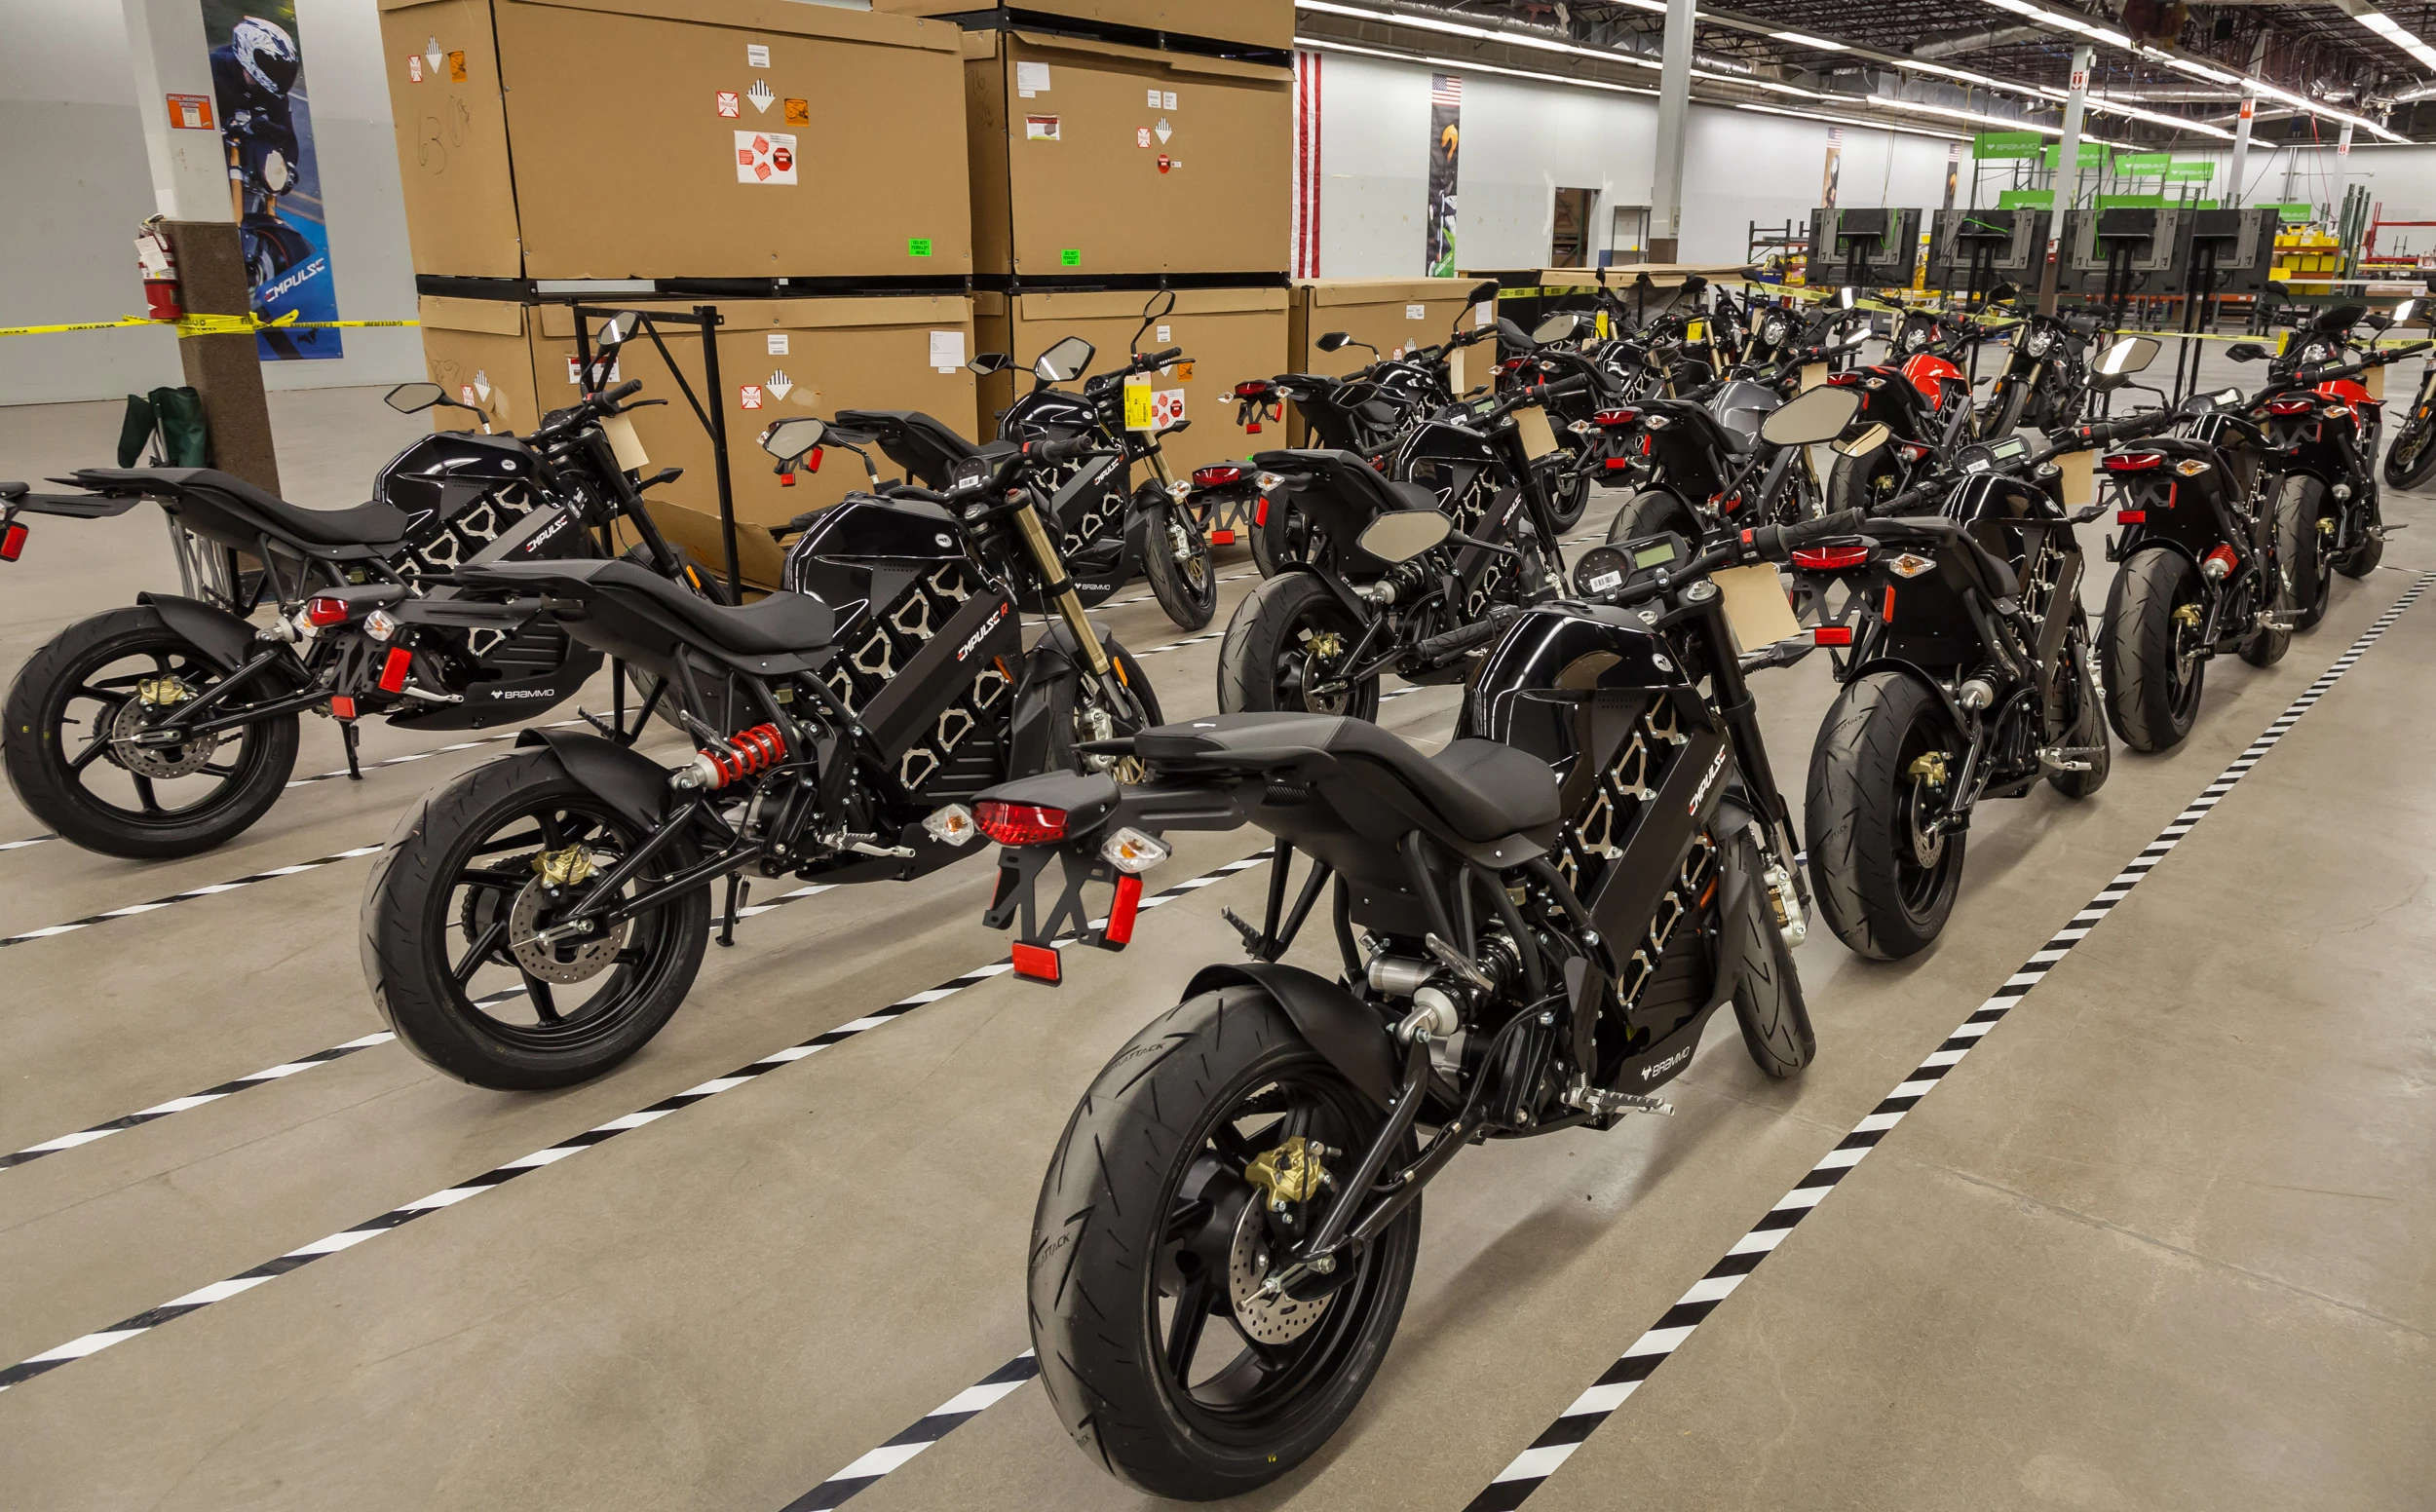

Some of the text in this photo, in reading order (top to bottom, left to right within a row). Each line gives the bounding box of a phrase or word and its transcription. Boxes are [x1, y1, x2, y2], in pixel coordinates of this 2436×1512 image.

[264, 257, 324, 302] EMPULSE
[526, 514, 568, 552] EMPULSE
[957, 602, 1009, 662] EMPULSE R
[504, 688, 554, 699] BRAMMO
[1688, 743, 1727, 816] EMPULSE
[1652, 1045, 1691, 1077] BRAMMO
